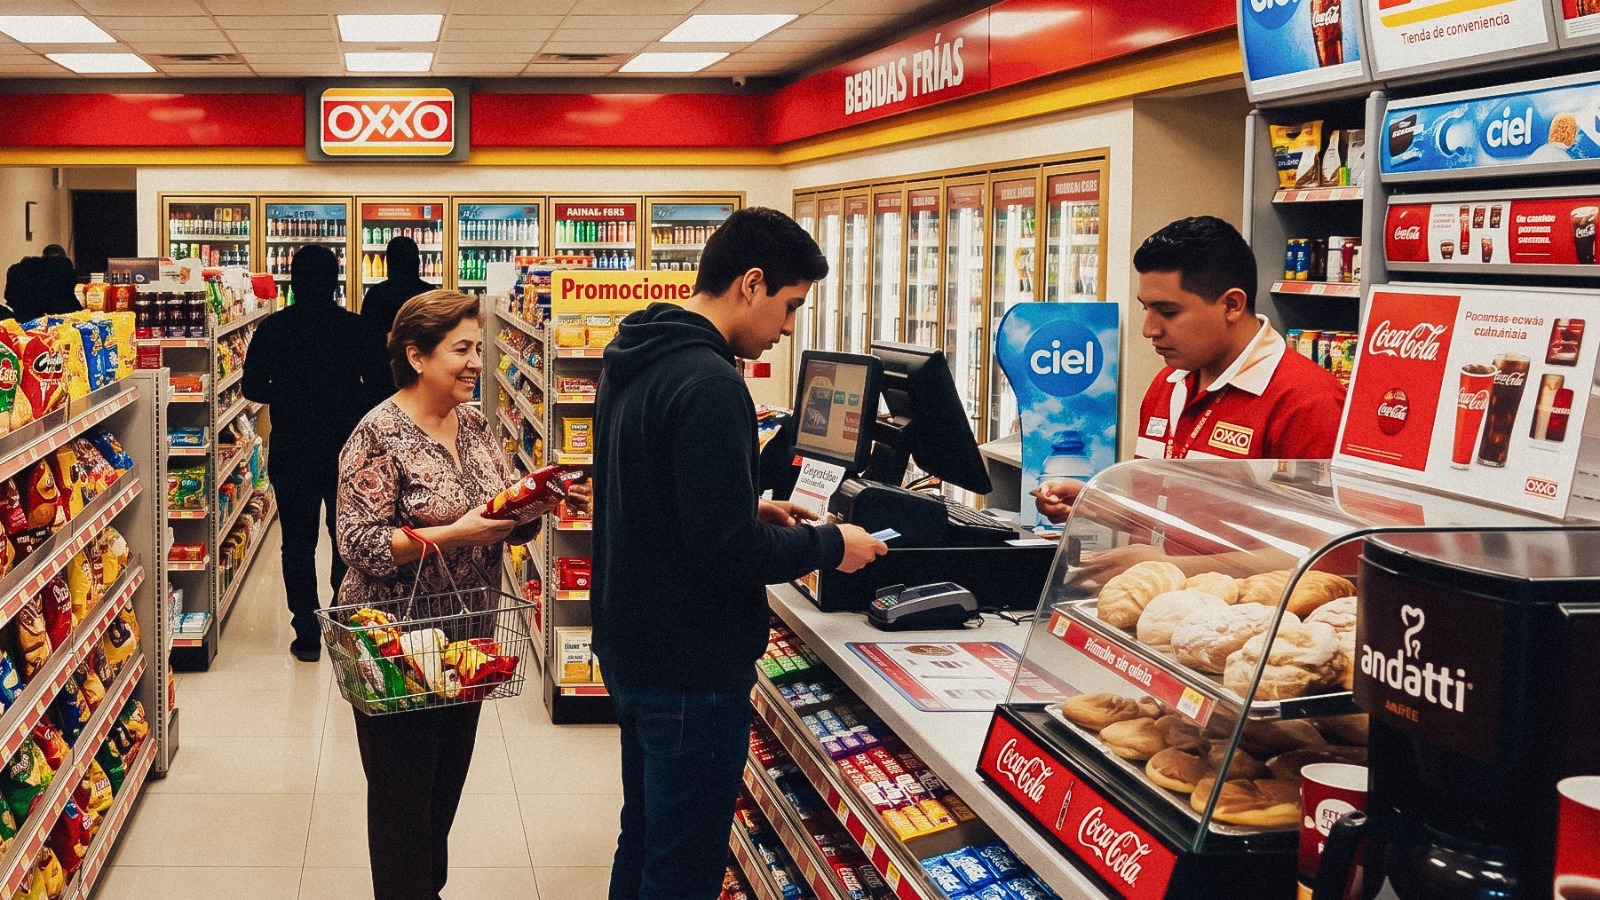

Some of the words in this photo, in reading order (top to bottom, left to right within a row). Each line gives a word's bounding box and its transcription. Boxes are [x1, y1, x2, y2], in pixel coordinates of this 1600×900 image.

[1401, 28, 1431, 45] Tienda
[1433, 26, 1445, 39] de
[1446, 12, 1511, 36] conveniencia
[845, 57, 907, 115] BEBIDAS
[912, 33, 964, 97] FRÍAS
[328, 101, 448, 142] OXXO
[1486, 106, 1533, 148] ciel
[562, 277, 695, 300] Promocione
[1030, 339, 1094, 375] ciel
[1213, 428, 1249, 448] OXXO
[1526, 479, 1557, 496] OXXO
[1361, 644, 1466, 713] andatti
